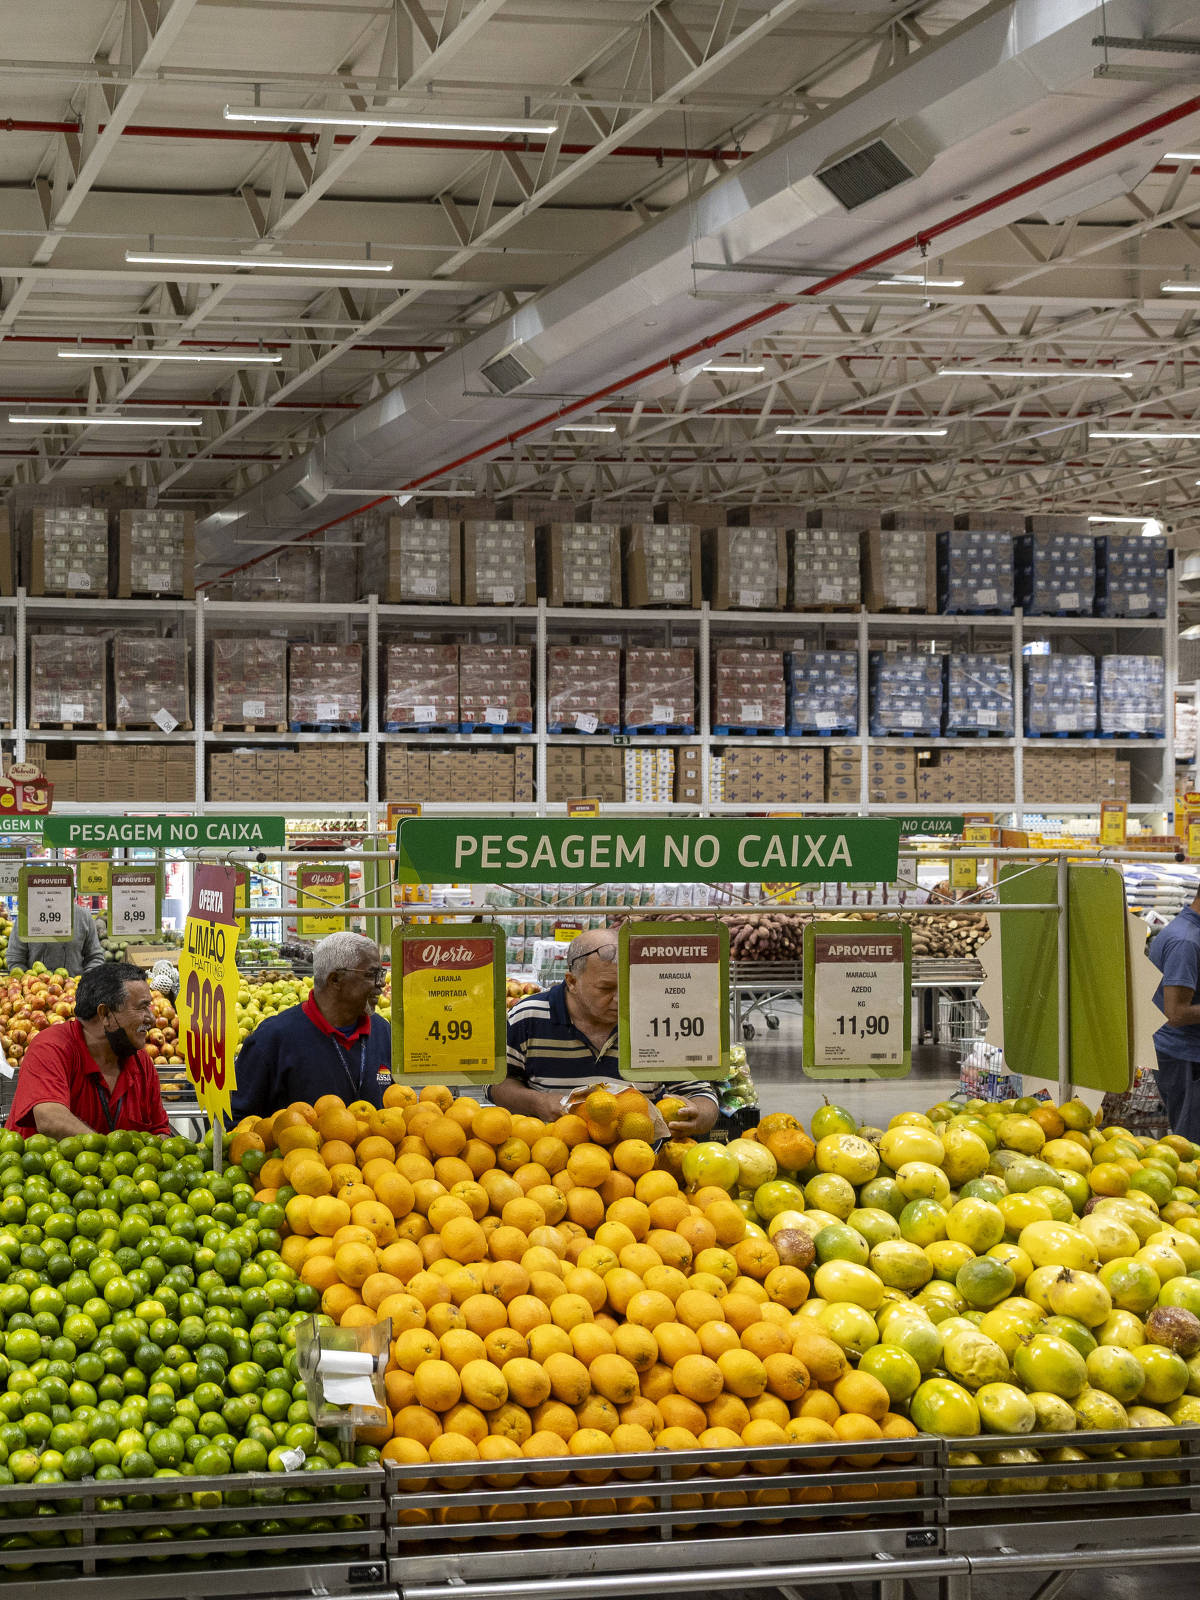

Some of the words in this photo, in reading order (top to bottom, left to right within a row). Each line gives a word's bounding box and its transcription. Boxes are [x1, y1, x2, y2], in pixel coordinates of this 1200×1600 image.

[69, 824, 162, 841] PESAGEM
[170, 823, 198, 841] NO
[206, 823, 263, 840] CAIXA
[901, 820, 918, 831] NO
[921, 820, 952, 831] CAIXA
[454, 835, 647, 869] PESAGEM
[663, 834, 721, 869] NO
[737, 834, 853, 869] CAIXA
[311, 874, 337, 884] Oferta
[198, 888, 224, 914] OFERTA
[40, 912, 61, 923] 8,99
[123, 911, 146, 923] 8,99
[188, 920, 226, 964] LIMÃO
[422, 944, 475, 967] Oferta
[641, 946, 708, 957] APROVEITE
[828, 945, 893, 956] APROVEITE
[434, 975, 462, 983] LARANJA
[428, 989, 468, 998] IMPORTADA
[664, 987, 686, 995] AZEDO
[186, 970, 226, 1094] 3,89
[428, 1020, 473, 1044] 4,99
[650, 1016, 705, 1041] 11,90
[836, 1015, 889, 1039] 11,90
